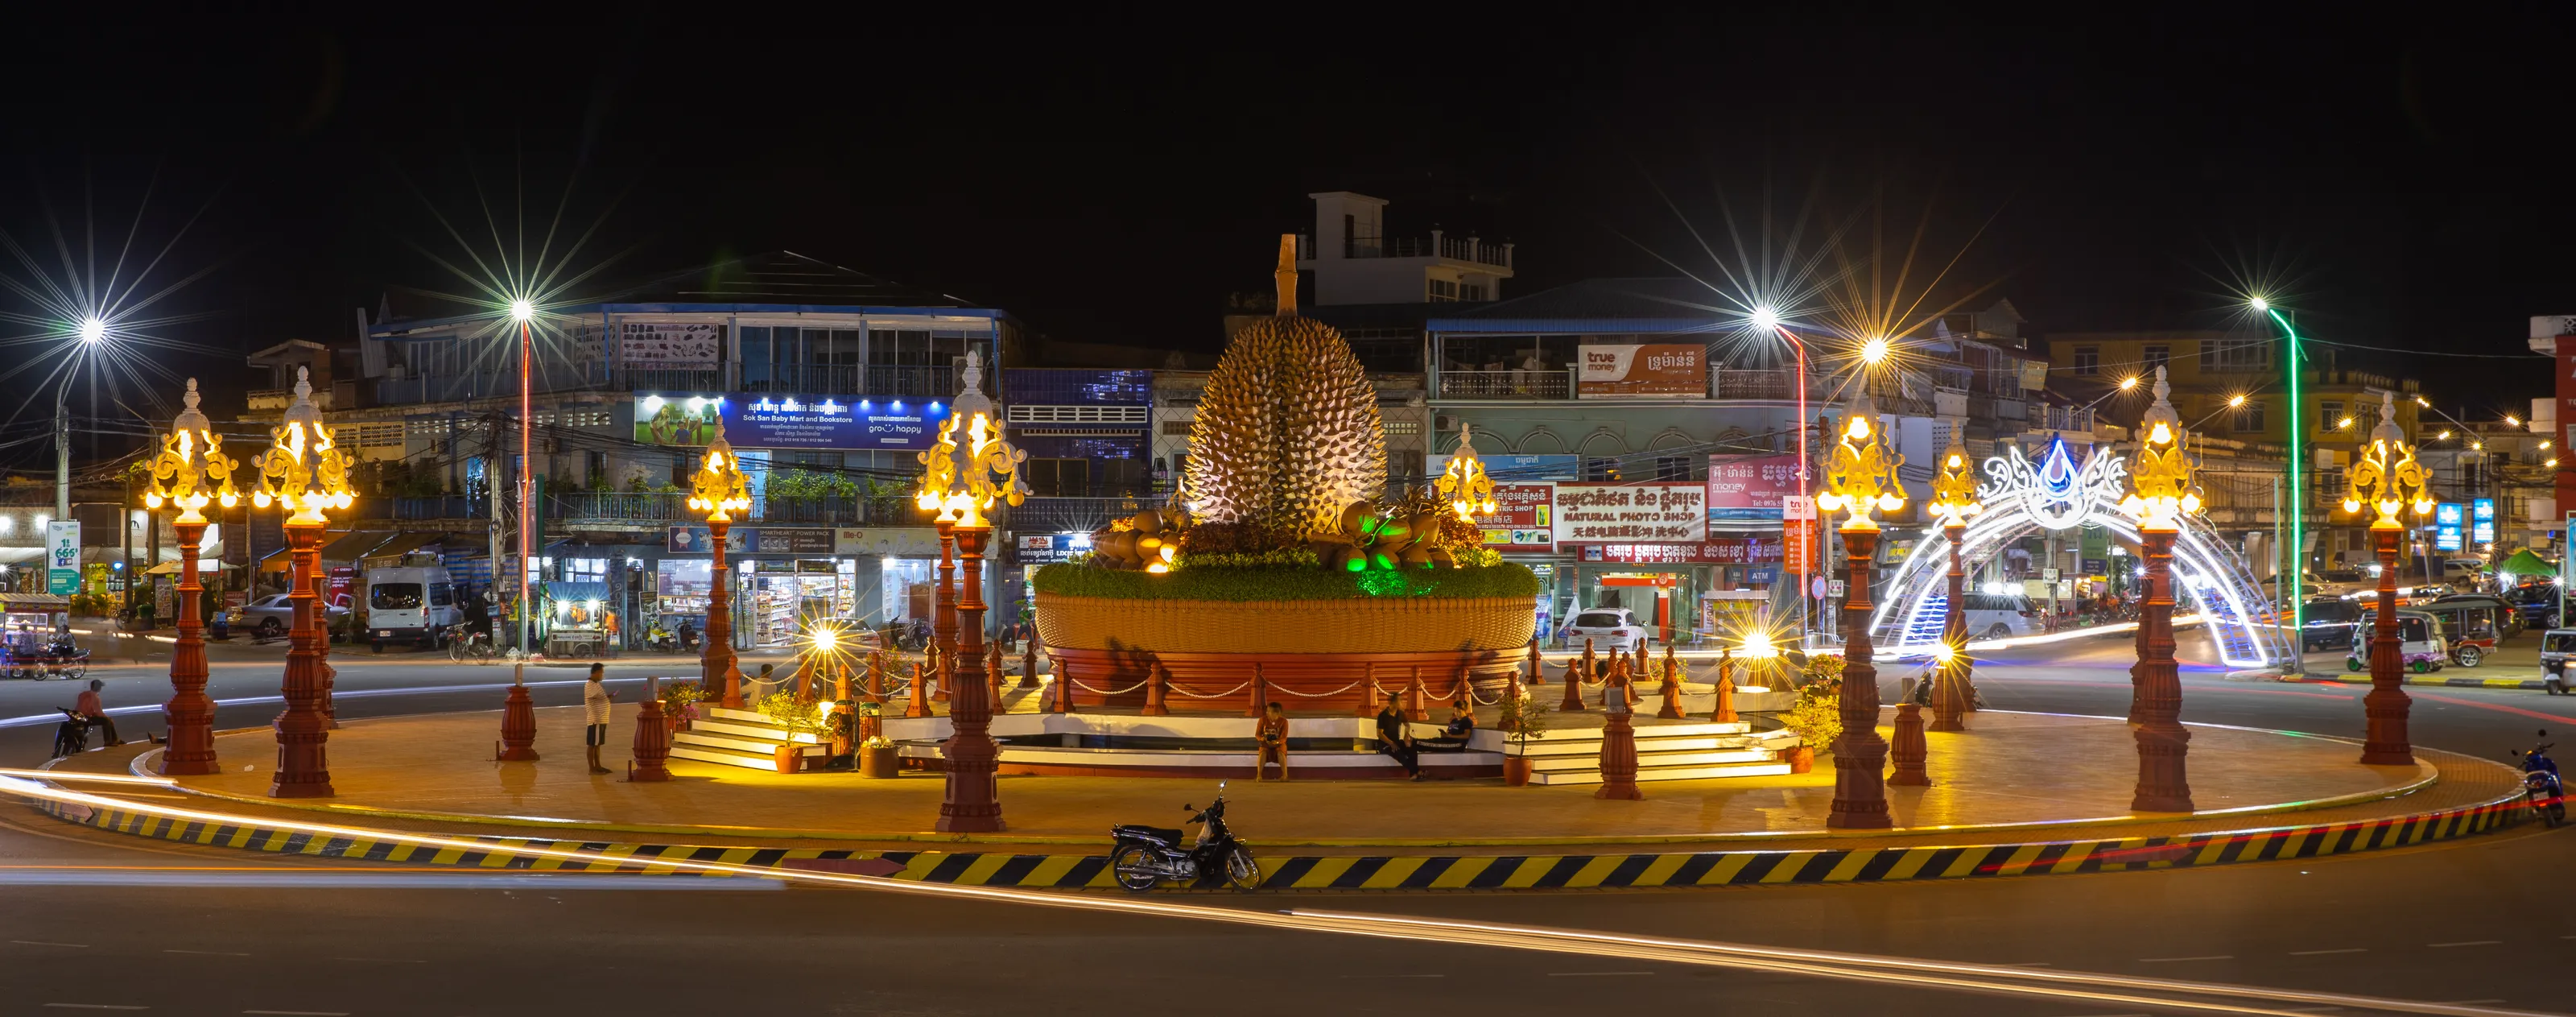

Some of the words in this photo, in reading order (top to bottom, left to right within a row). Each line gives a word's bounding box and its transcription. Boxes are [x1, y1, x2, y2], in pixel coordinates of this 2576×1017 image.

[1587, 352, 1615, 362] true
[1587, 364, 1616, 373] money
[896, 425, 921, 433] happy
[1712, 483, 1746, 491] money
[1564, 513, 1616, 522] NATURAL
[1620, 513, 1660, 522] PHOTO
[1664, 513, 1696, 522] SHOP
